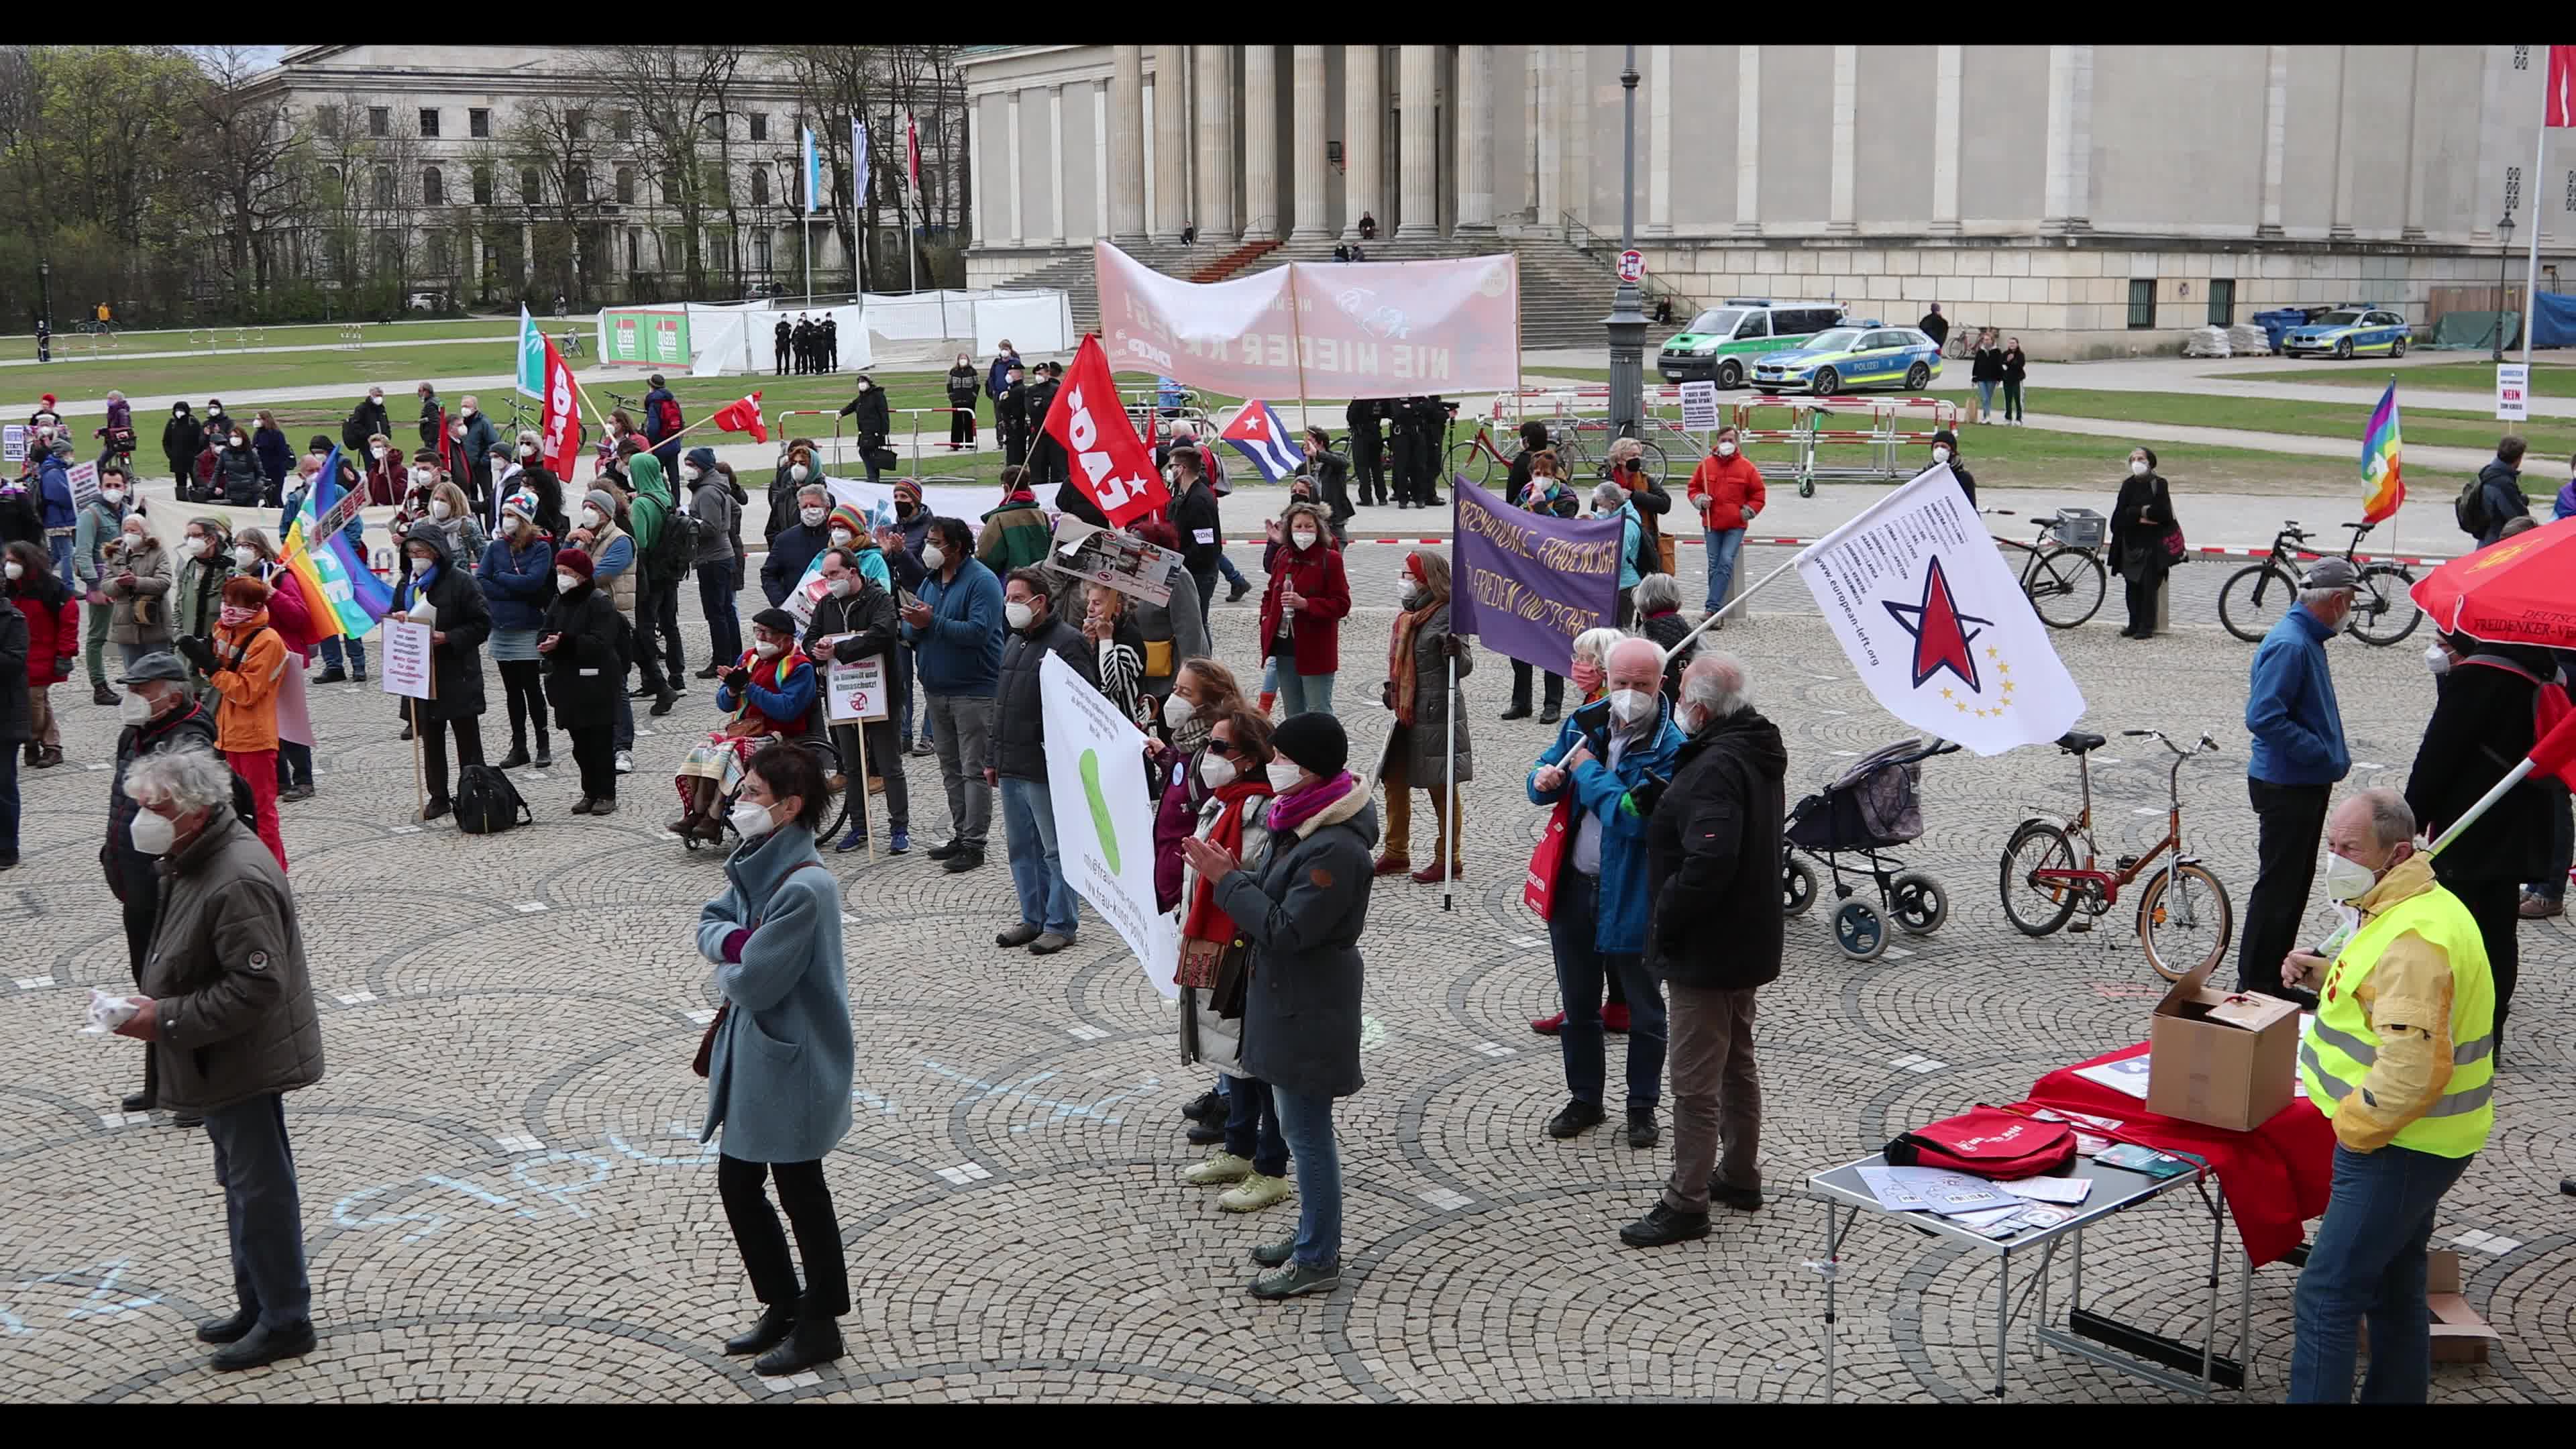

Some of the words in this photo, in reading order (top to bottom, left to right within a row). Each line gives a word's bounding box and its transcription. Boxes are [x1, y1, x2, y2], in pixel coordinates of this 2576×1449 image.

[1854, 362, 1880, 371] POLIZEI
[2502, 389, 2521, 401] NEIN
[1537, 537, 1618, 575] FRAUENLIGA
[1474, 569, 1524, 613] FRIEDEN
[1814, 556, 1880, 667] www.european-left.org
